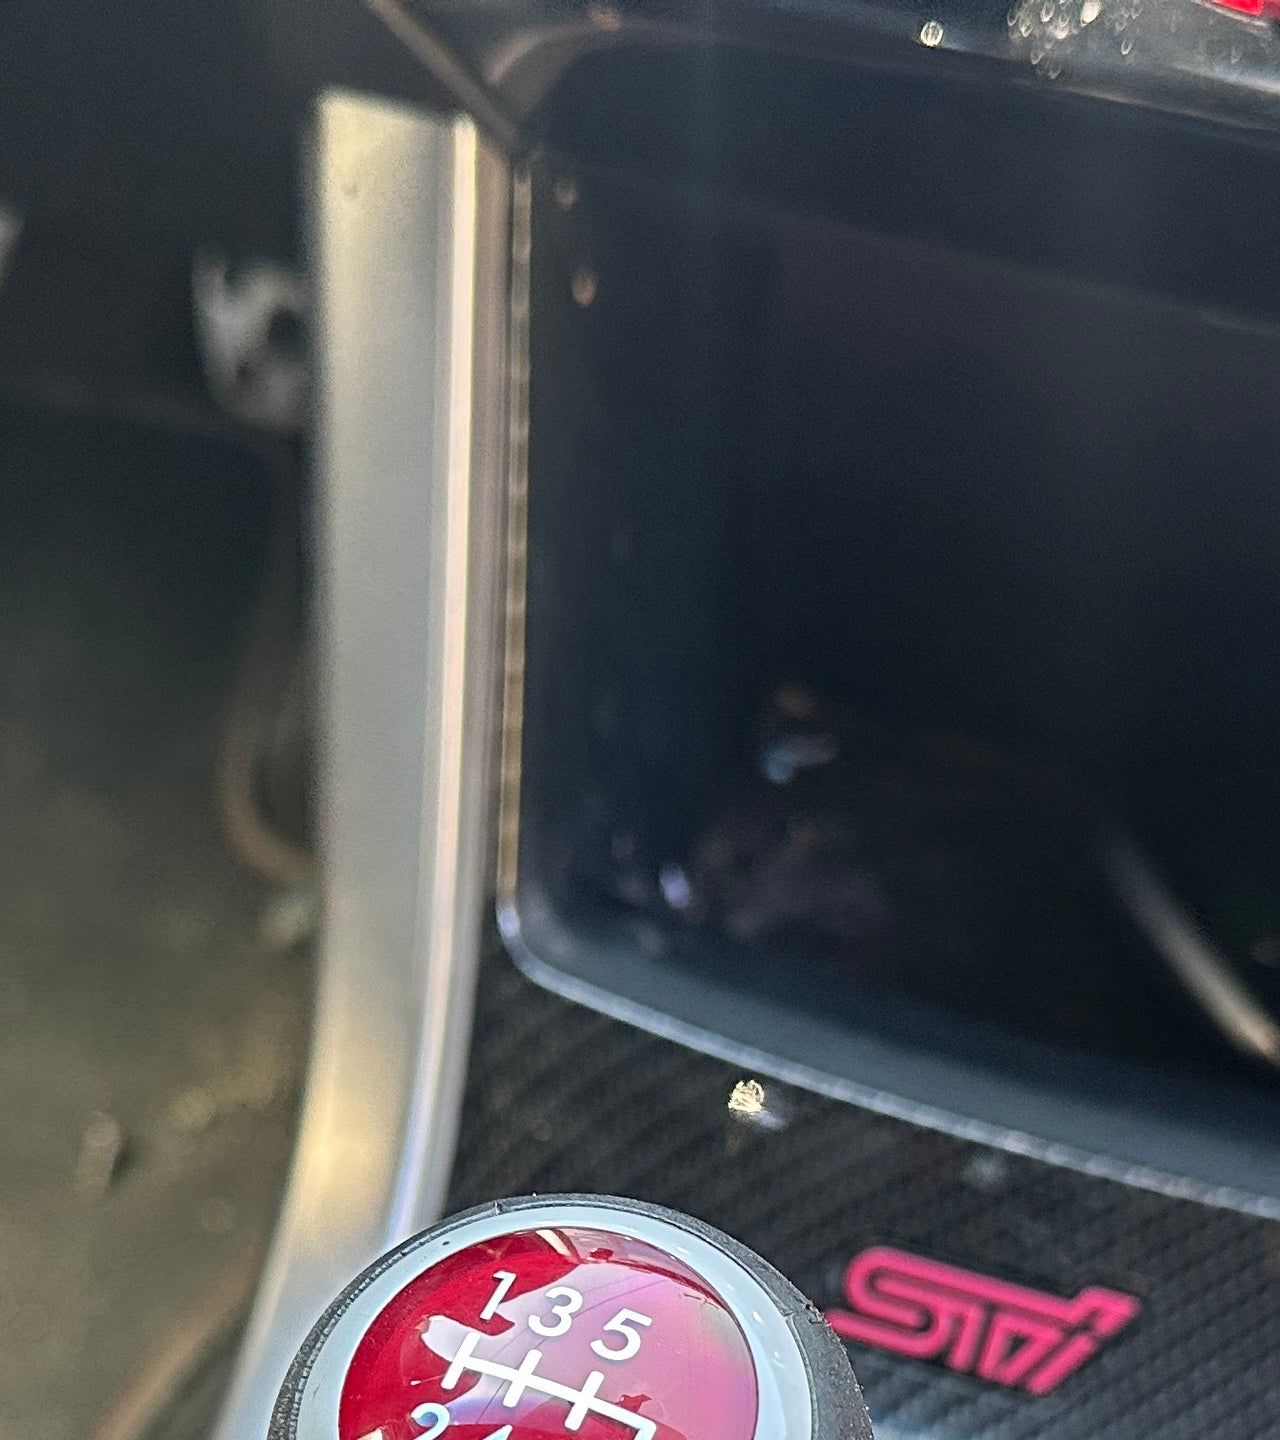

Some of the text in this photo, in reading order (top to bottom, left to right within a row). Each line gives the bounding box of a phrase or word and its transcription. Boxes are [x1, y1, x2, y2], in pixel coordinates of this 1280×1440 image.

[479, 1269, 653, 1362] 1 3 5
